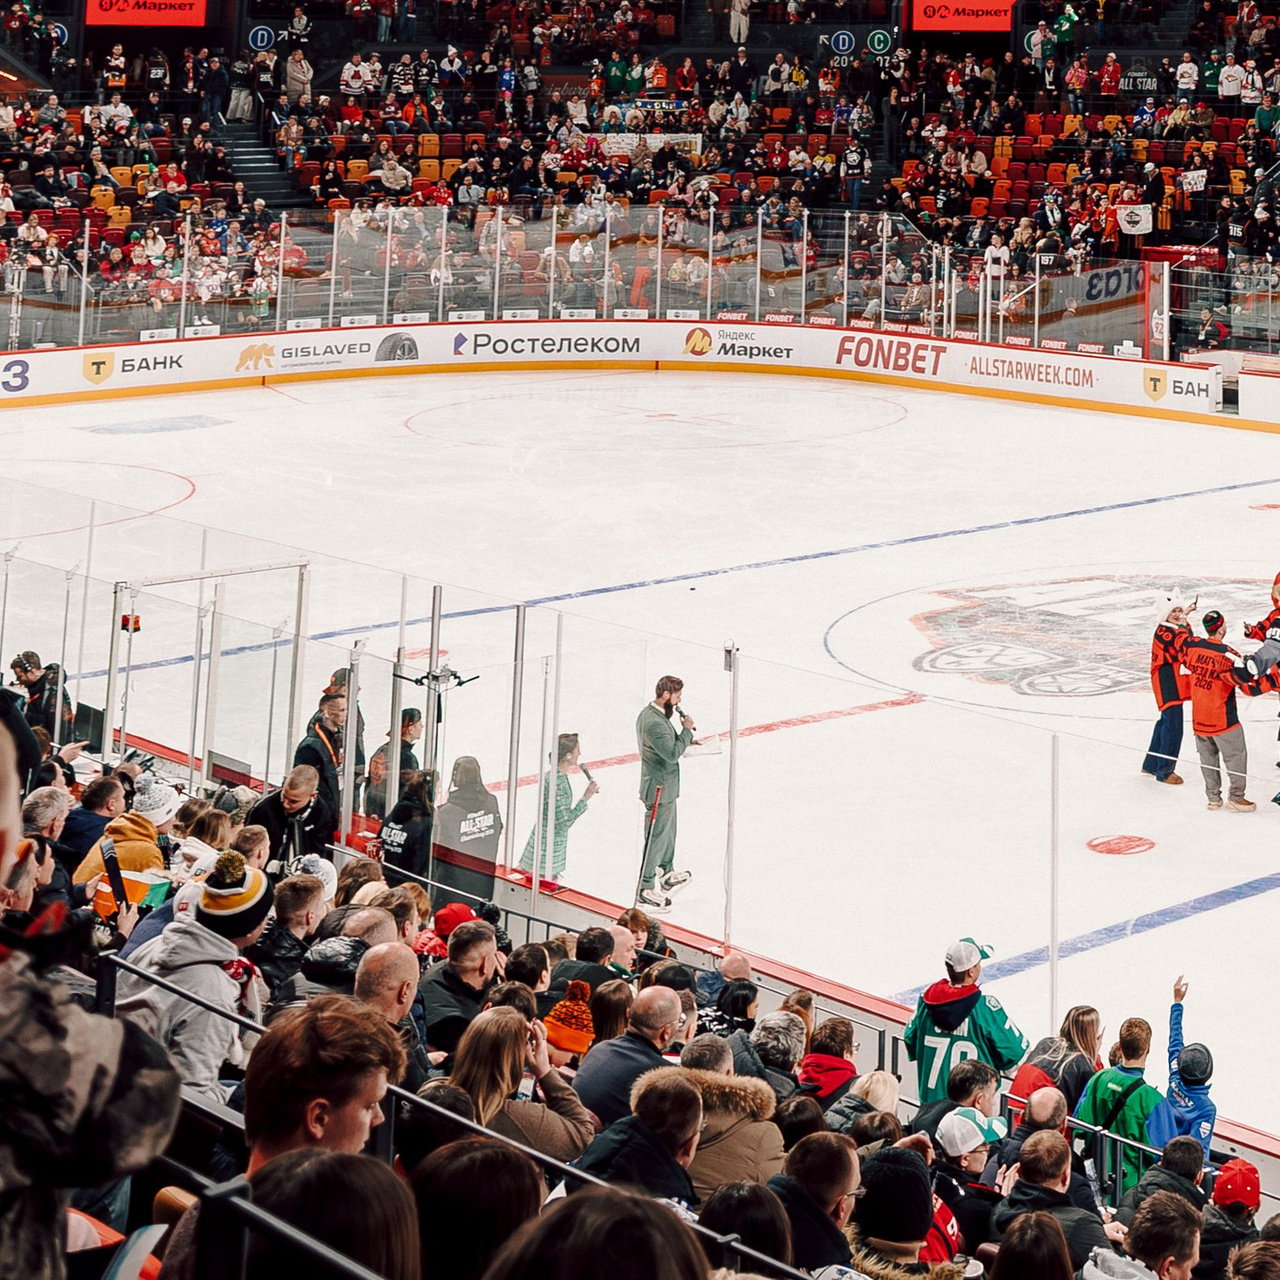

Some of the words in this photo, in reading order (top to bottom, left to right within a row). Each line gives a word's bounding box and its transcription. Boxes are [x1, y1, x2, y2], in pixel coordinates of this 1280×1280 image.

[131, 0, 196, 13] Маркет
[952, 7, 1010, 19] Маркет
[1119, 78, 1134, 91] ALL
[1136, 78, 1158, 91] STAR
[717, 312, 748, 321] FONBET
[765, 314, 795, 323] FONBET
[809, 316, 837, 326] FONBET
[850, 319, 875, 329] FONBET
[884, 322, 907, 333] FONBET
[907, 325, 932, 335] FONBET
[954, 330, 979, 340] FONBET
[718, 329, 756, 344] Яндекс
[1005, 335, 1031, 346] FONBET
[473, 333, 641, 356] Ростелеком
[1041, 340, 1067, 350] FONBET
[1077, 344, 1104, 354] FONBET
[281, 342, 371, 359] GISLAVED
[717, 343, 793, 360] Маркет
[835, 335, 947, 376] FONBET
[121, 354, 183, 373] БАНК
[970, 356, 1094, 388] ALLSTARWEEK.COM
